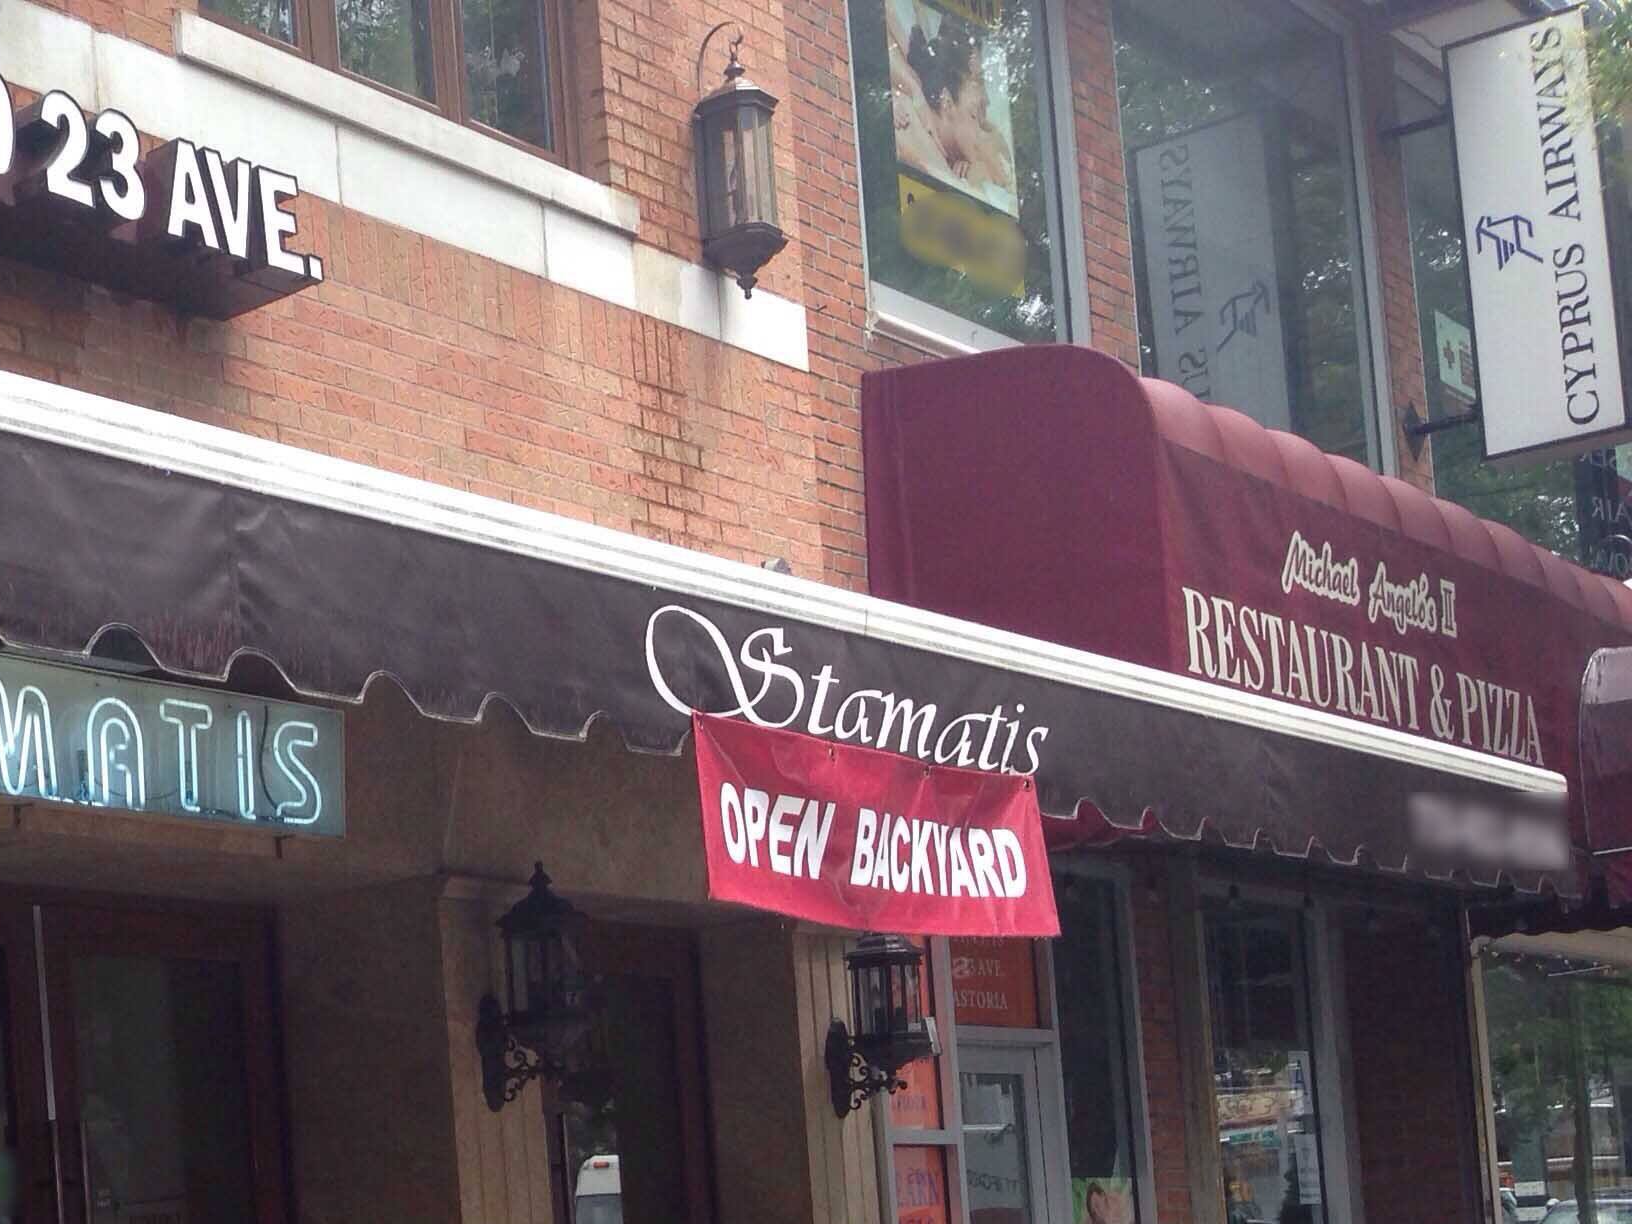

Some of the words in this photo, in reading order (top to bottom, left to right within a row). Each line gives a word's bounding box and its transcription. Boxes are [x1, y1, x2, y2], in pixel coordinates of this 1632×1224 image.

[39, 89, 147, 221] 23
[167, 137, 324, 283] AVE.
[1529, 25, 1583, 221] AIRWAYS
[1552, 241, 1601, 426] CYPRUS
[1281, 530, 1360, 607] Michael
[1440, 577, 1458, 639] II
[645, 604, 1049, 777] Stamatis
[1182, 586, 1420, 732] RESTAURANT
[1429, 663, 1456, 741] &
[1455, 671, 1545, 767] PIZZA
[720, 781, 837, 880] OPEN
[850, 808, 1029, 899] BACKYARD
